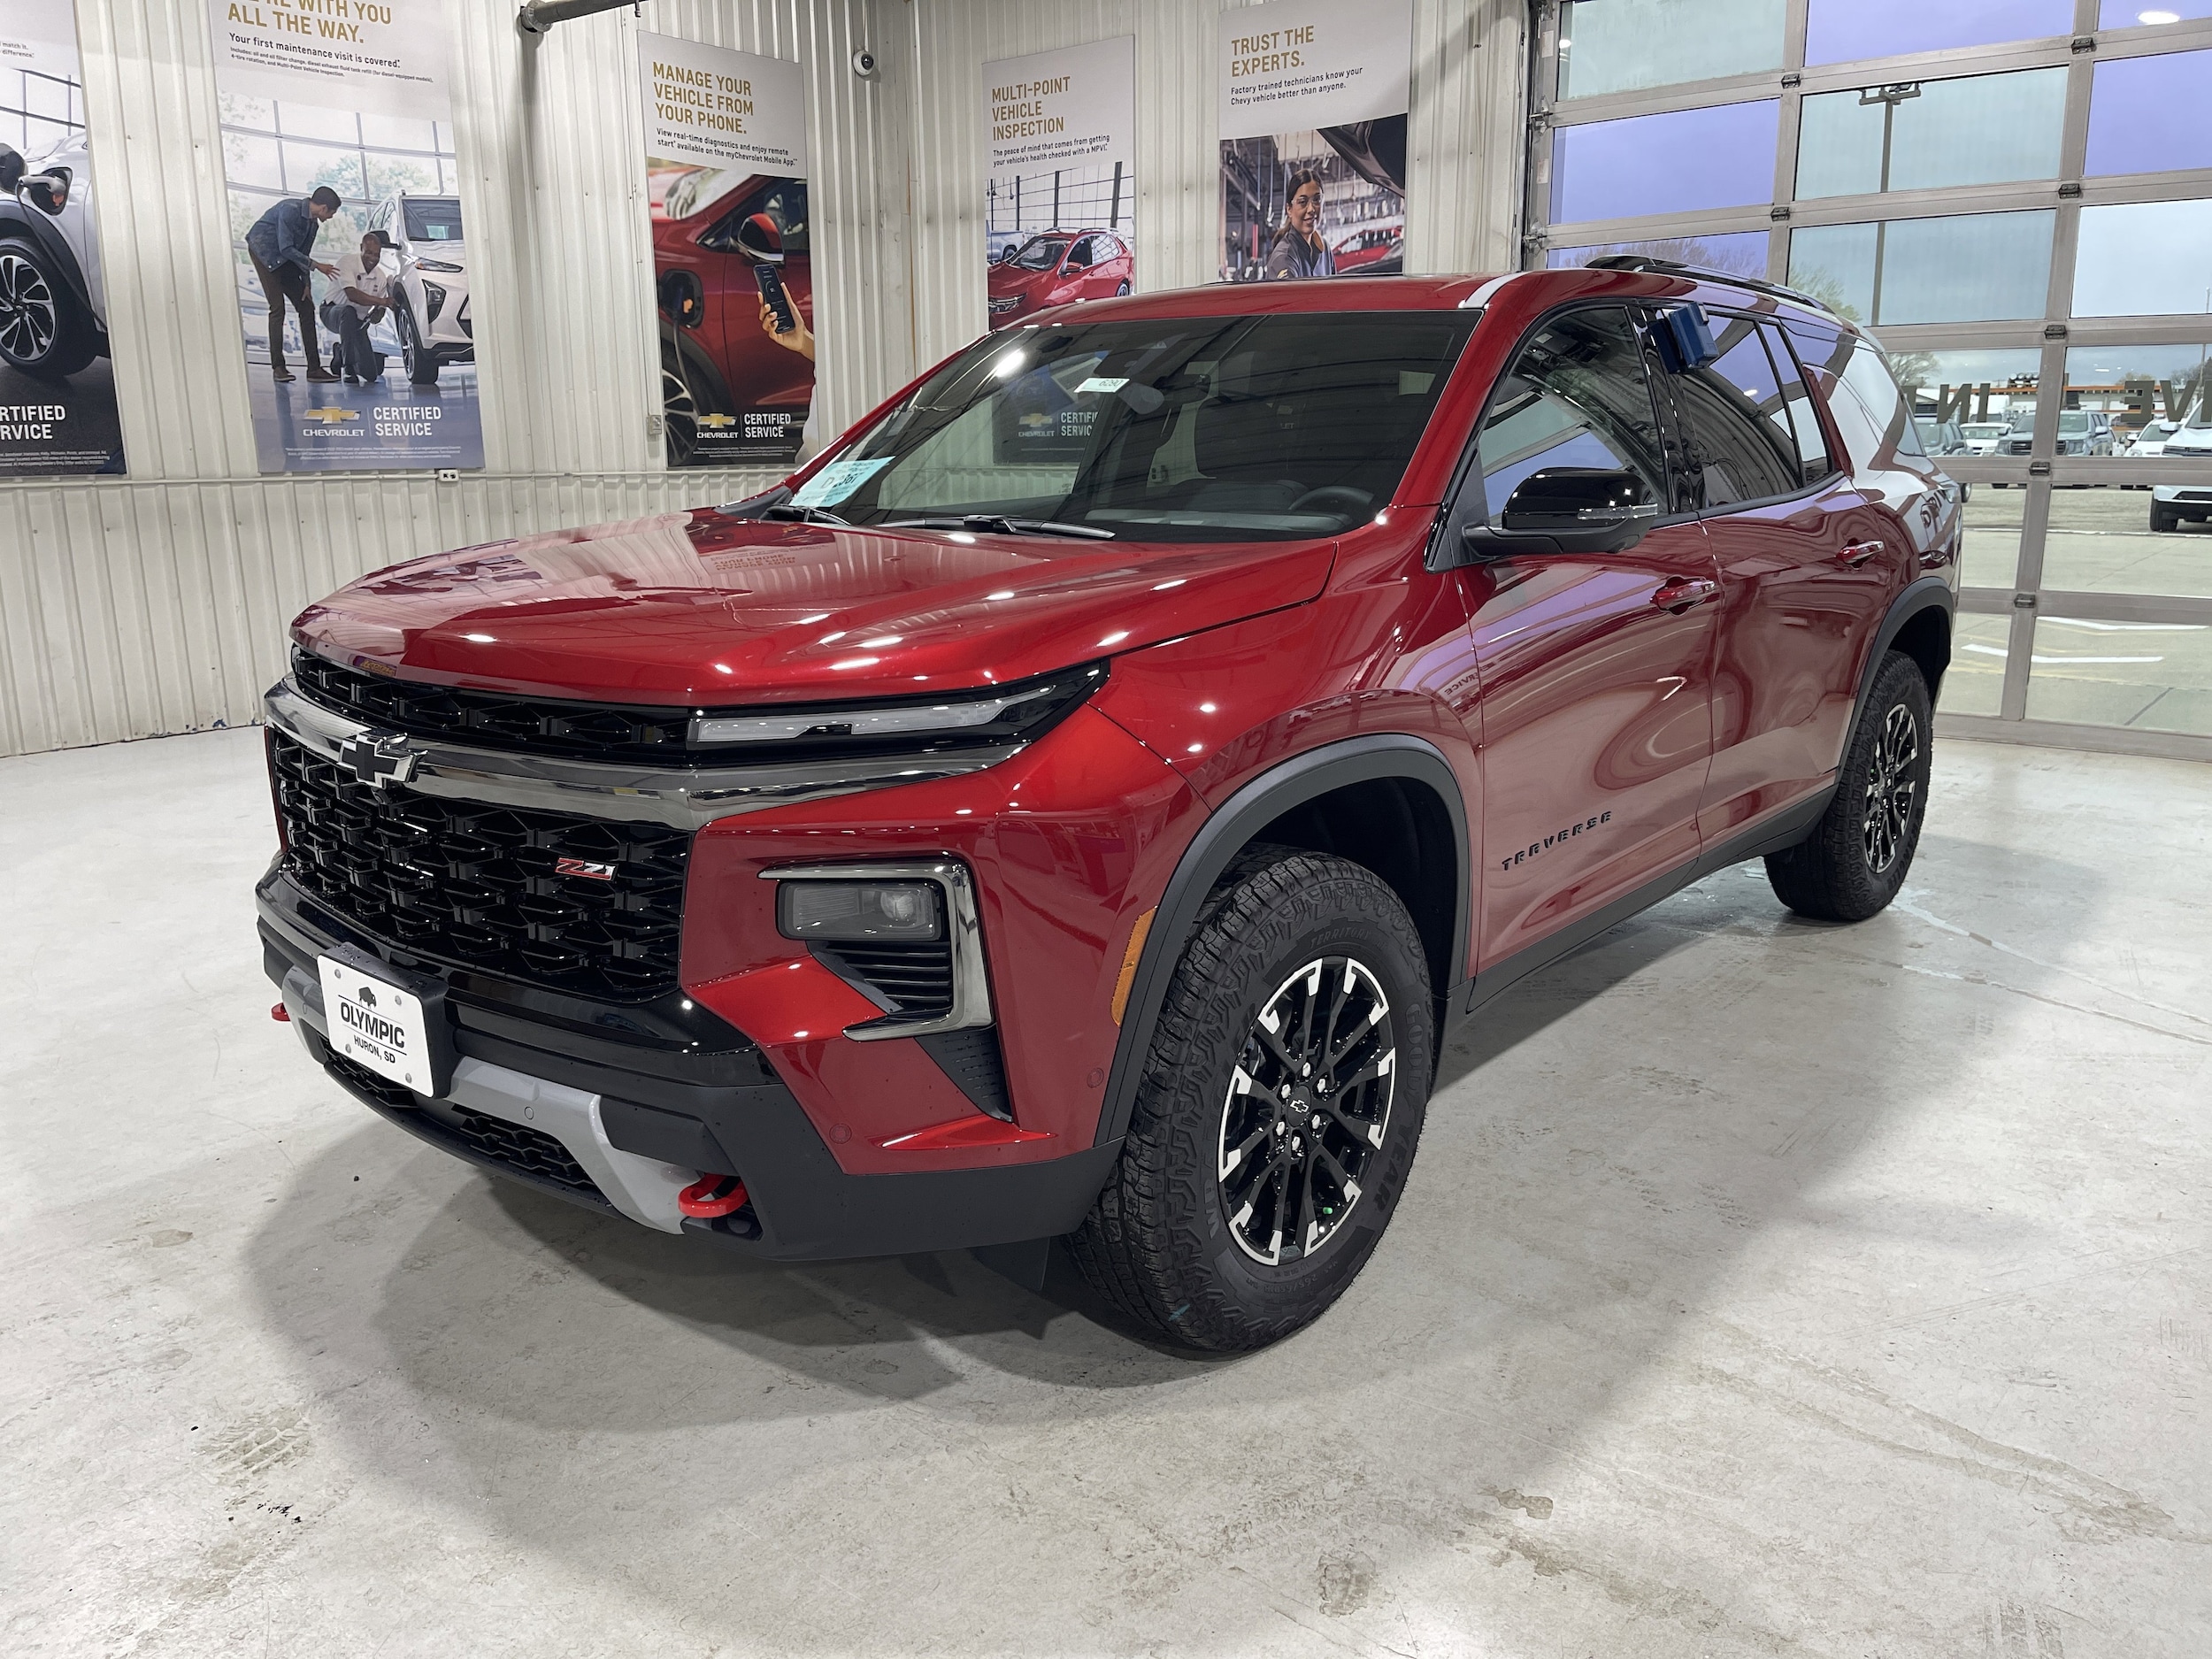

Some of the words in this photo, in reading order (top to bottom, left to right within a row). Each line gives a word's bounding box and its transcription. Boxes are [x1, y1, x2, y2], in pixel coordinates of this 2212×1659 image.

[227, 3, 267, 27] ALL
[272, 11, 312, 35] THE
[317, 19, 365, 43] WAY.
[354, 2, 392, 25] YOU
[228, 32, 250, 44] Your
[253, 36, 274, 49] first
[276, 42, 333, 58] maintenance
[334, 51, 353, 62] visit
[355, 53, 363, 63] is
[1231, 32, 1280, 56] TRUST
[1284, 25, 1315, 46] THE
[1231, 50, 1305, 78] EXPERTS.
[653, 61, 712, 89] MANAGE
[716, 75, 751, 96] YOUR
[991, 76, 1071, 103] MULTI-POINT
[1231, 85, 1256, 96] Factory
[1258, 80, 1282, 91] trained
[1284, 74, 1324, 87] technicians
[1325, 72, 1345, 81] know
[1346, 67, 1363, 78] your
[653, 82, 713, 109] VEHICLE
[717, 95, 754, 116] FROM
[1231, 96, 1251, 105] Chevy
[1252, 93, 1276, 103] vehicle
[1278, 89, 1299, 99] better
[1301, 87, 1317, 96] than
[1318, 82, 1347, 93] anyone.
[655, 103, 694, 125] YOUR
[697, 111, 748, 134] PHONE.
[992, 101, 1042, 122] VEHICLE
[657, 127, 672, 138] View
[673, 131, 703, 143] real-time
[703, 136, 739, 150] diagnostics
[740, 142, 750, 151] and
[751, 145, 767, 155] enjoy
[992, 116, 1064, 142] INSPECTION
[677, 142, 704, 154] available
[714, 148, 725, 157] the
[726, 150, 763, 163] myChevrolet
[764, 155, 782, 165] Mobile
[993, 159, 1005, 168] your
[1006, 154, 1029, 165] vehicle's
[1030, 152, 1048, 162] health
[1048, 150, 1071, 159] checked
[1071, 147, 1085, 156] with
[1003, 148, 1019, 157] peace
[1041, 142, 1054, 150] that
[1088, 134, 1110, 145] getting
[373, 406, 442, 421] CERTIFIED
[744, 413, 791, 425] CERTIFIED
[303, 428, 365, 437] CHEVROLET
[375, 422, 433, 437] SERVICE
[744, 426, 784, 439] SERVICE
[1502, 810, 1612, 872] TRAVERSE
[555, 857, 616, 881] Z71
[1310, 927, 1371, 949] TERRITORY
[341, 1002, 405, 1048] OLYMPIC
[354, 1035, 382, 1061] HURON,
[385, 1050, 396, 1064] SD
